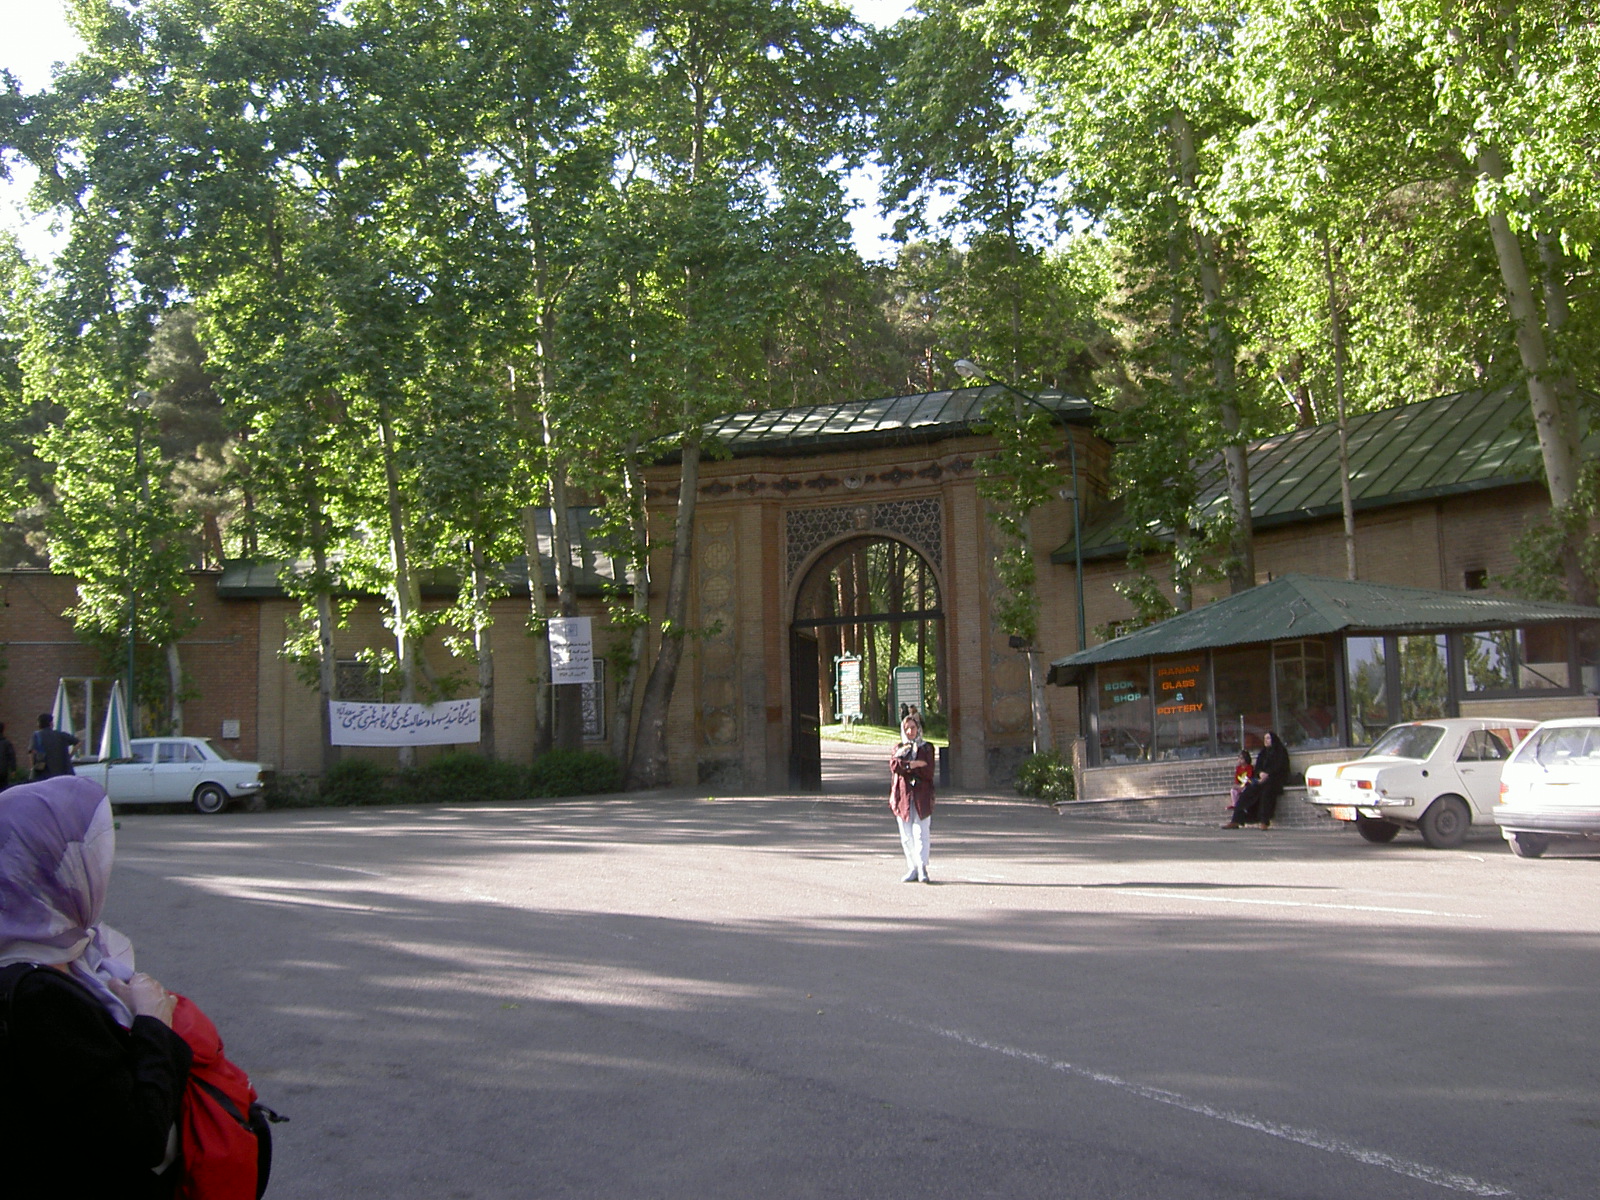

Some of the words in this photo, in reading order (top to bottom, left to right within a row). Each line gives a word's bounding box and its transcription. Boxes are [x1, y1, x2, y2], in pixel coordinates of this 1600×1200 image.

[1158, 665, 1200, 676] IRANIAN
[1104, 681, 1134, 691] BOOK
[1162, 679, 1196, 690] GLASS
[1113, 693, 1141, 703] SHOP
[1175, 693, 1184, 702] &
[1157, 703, 1204, 715] POTTERY
